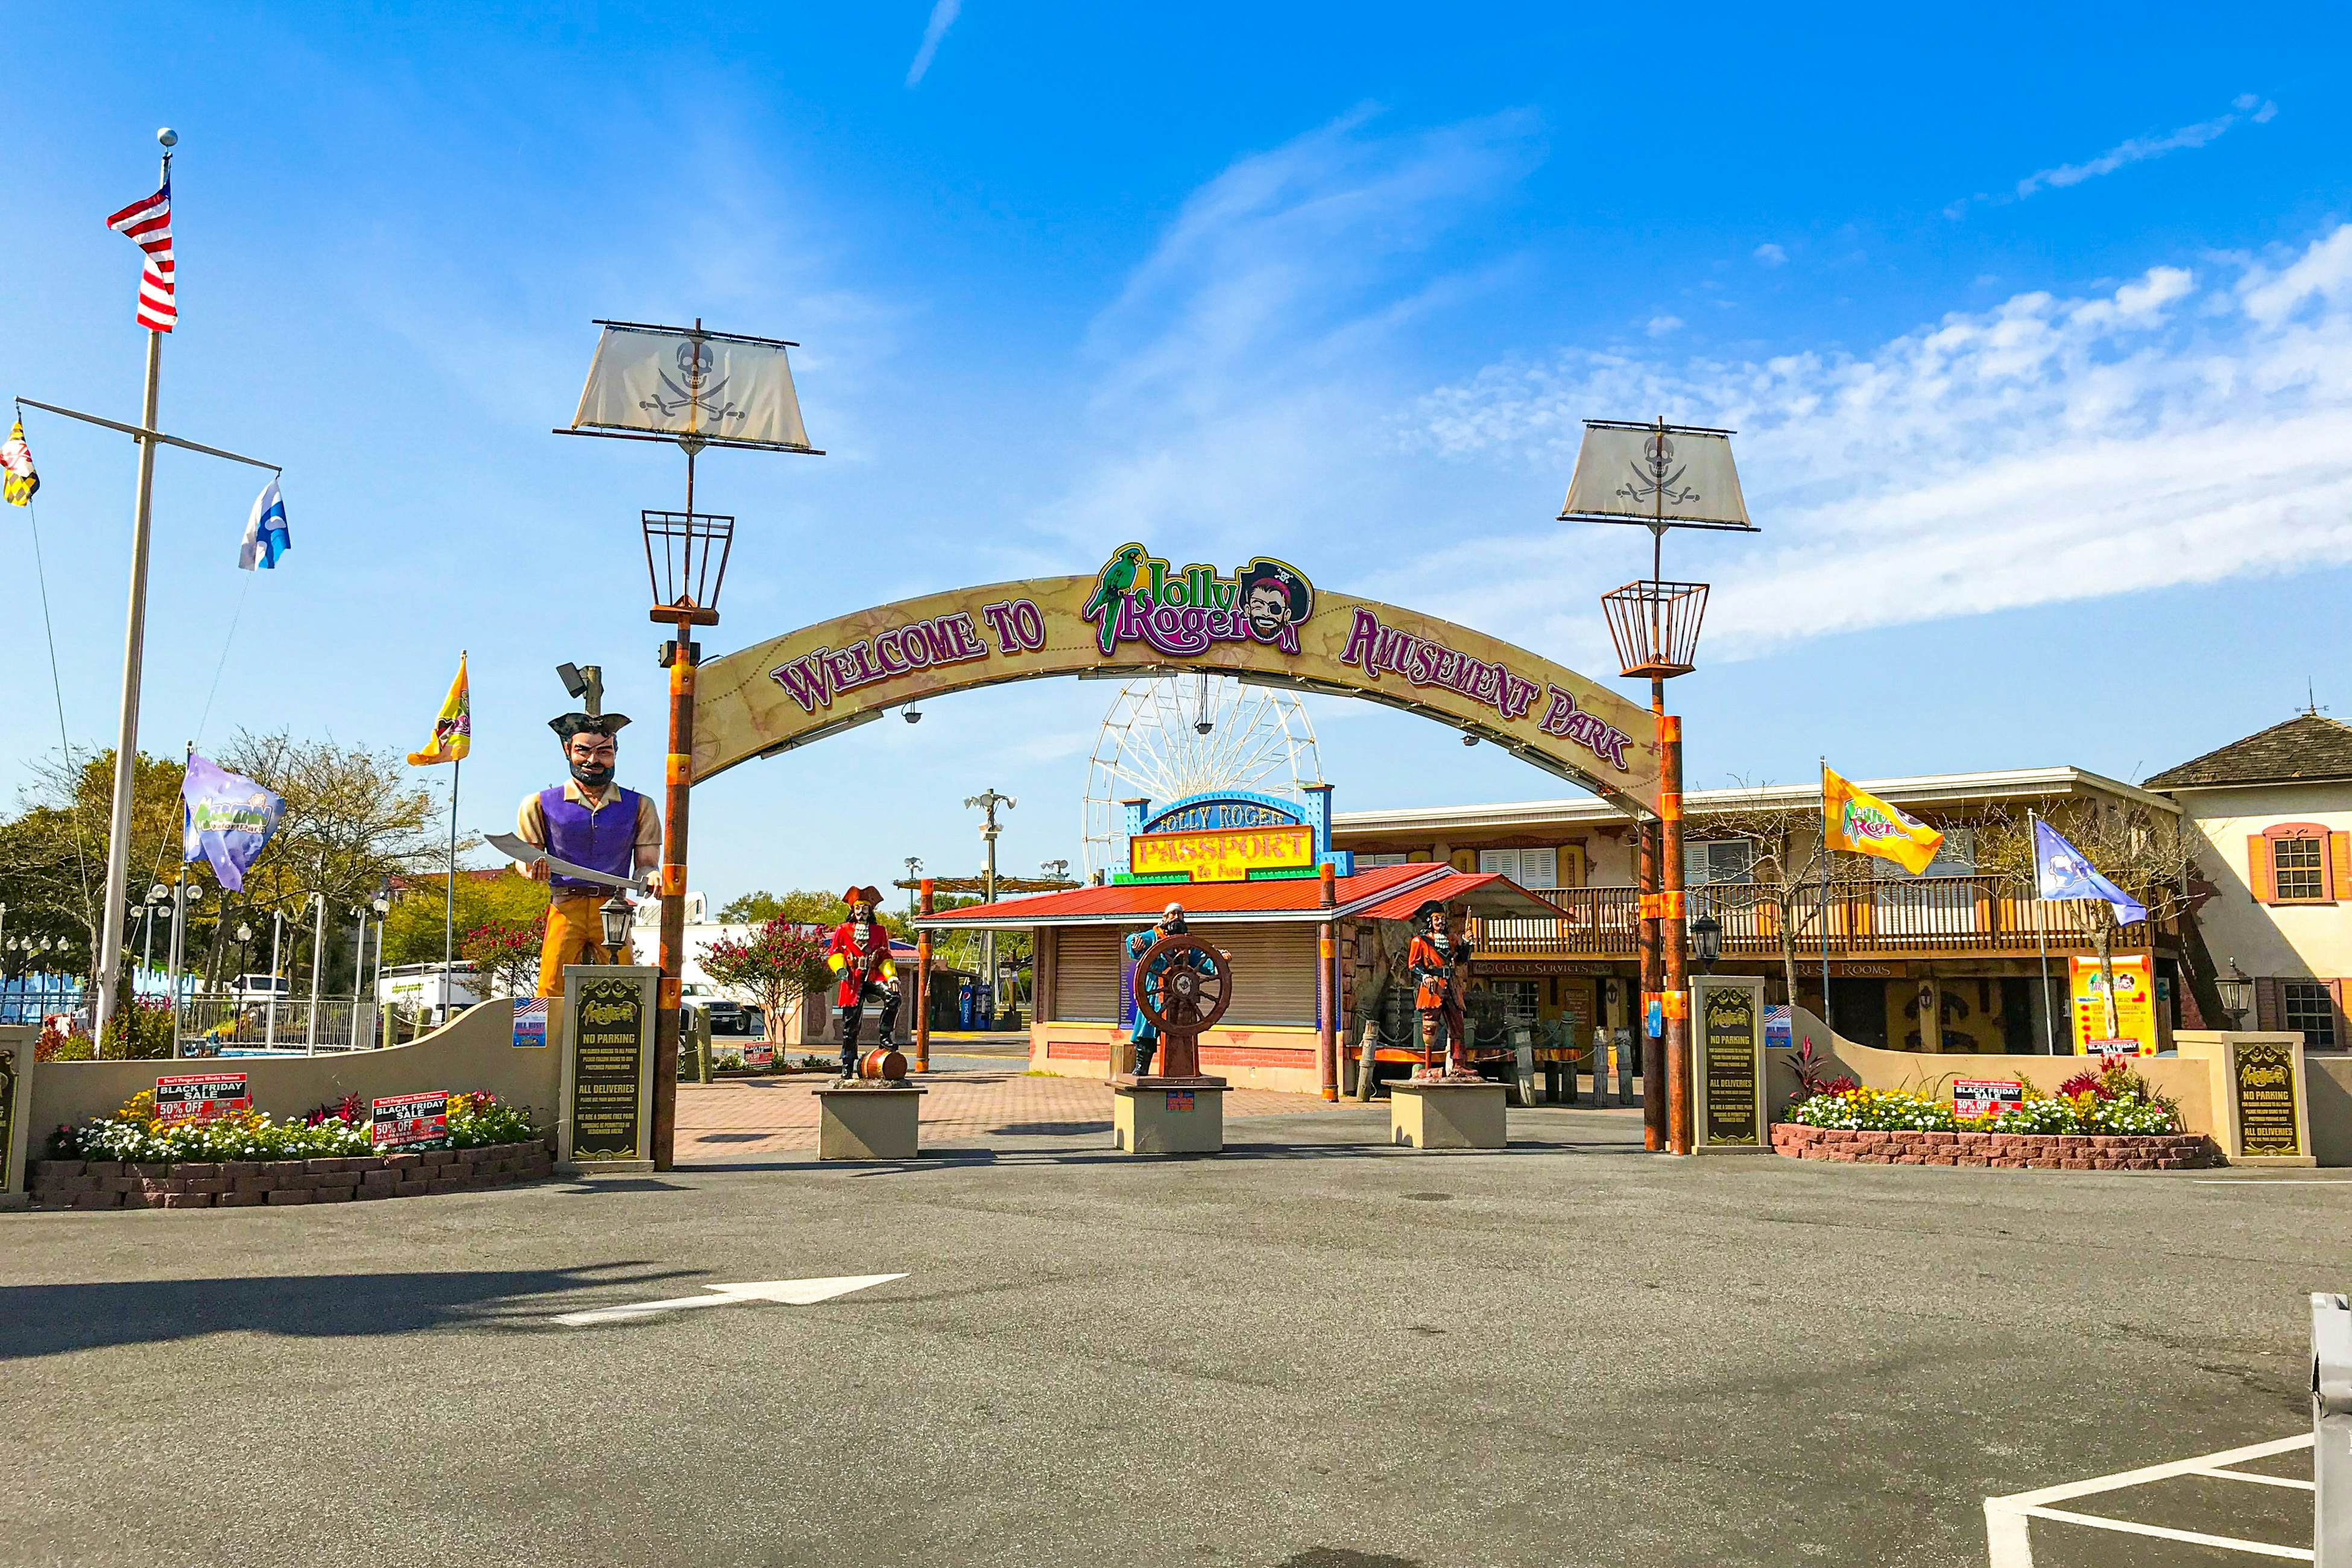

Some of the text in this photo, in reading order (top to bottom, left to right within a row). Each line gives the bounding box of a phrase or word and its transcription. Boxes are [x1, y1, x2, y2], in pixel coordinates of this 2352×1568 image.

[1136, 562, 1238, 618] Jolly
[1121, 594, 1248, 653] Roger
[770, 599, 1045, 711] WELCOME TO
[1339, 607, 1632, 770] AMUSEMENT PARK
[1156, 805, 1284, 832] JOLLY ROGER
[1139, 832, 1307, 867] PASSPORT
[1535, 964, 1589, 973] SERVICES
[1841, 964, 1891, 976] ROOMS
[583, 1034, 636, 1044] NO PARKING
[1710, 1035, 1750, 1044] NO PARKING
[160, 1083, 242, 1095] BLACK FRIDAY
[578, 1084, 635, 1093] ALL DELIVERIES
[1710, 1079, 1753, 1087] ALL DELIVERIES
[183, 1090, 218, 1100] SALE
[2243, 1091, 2289, 1100] NO PARKING
[159, 1101, 204, 1115] 50% OFF
[376, 1099, 445, 1116] BLACK FRIDAY
[1957, 1101, 1991, 1110] 50% OFF
[396, 1108, 425, 1120] SALE
[376, 1120, 414, 1135] 50% OFF
